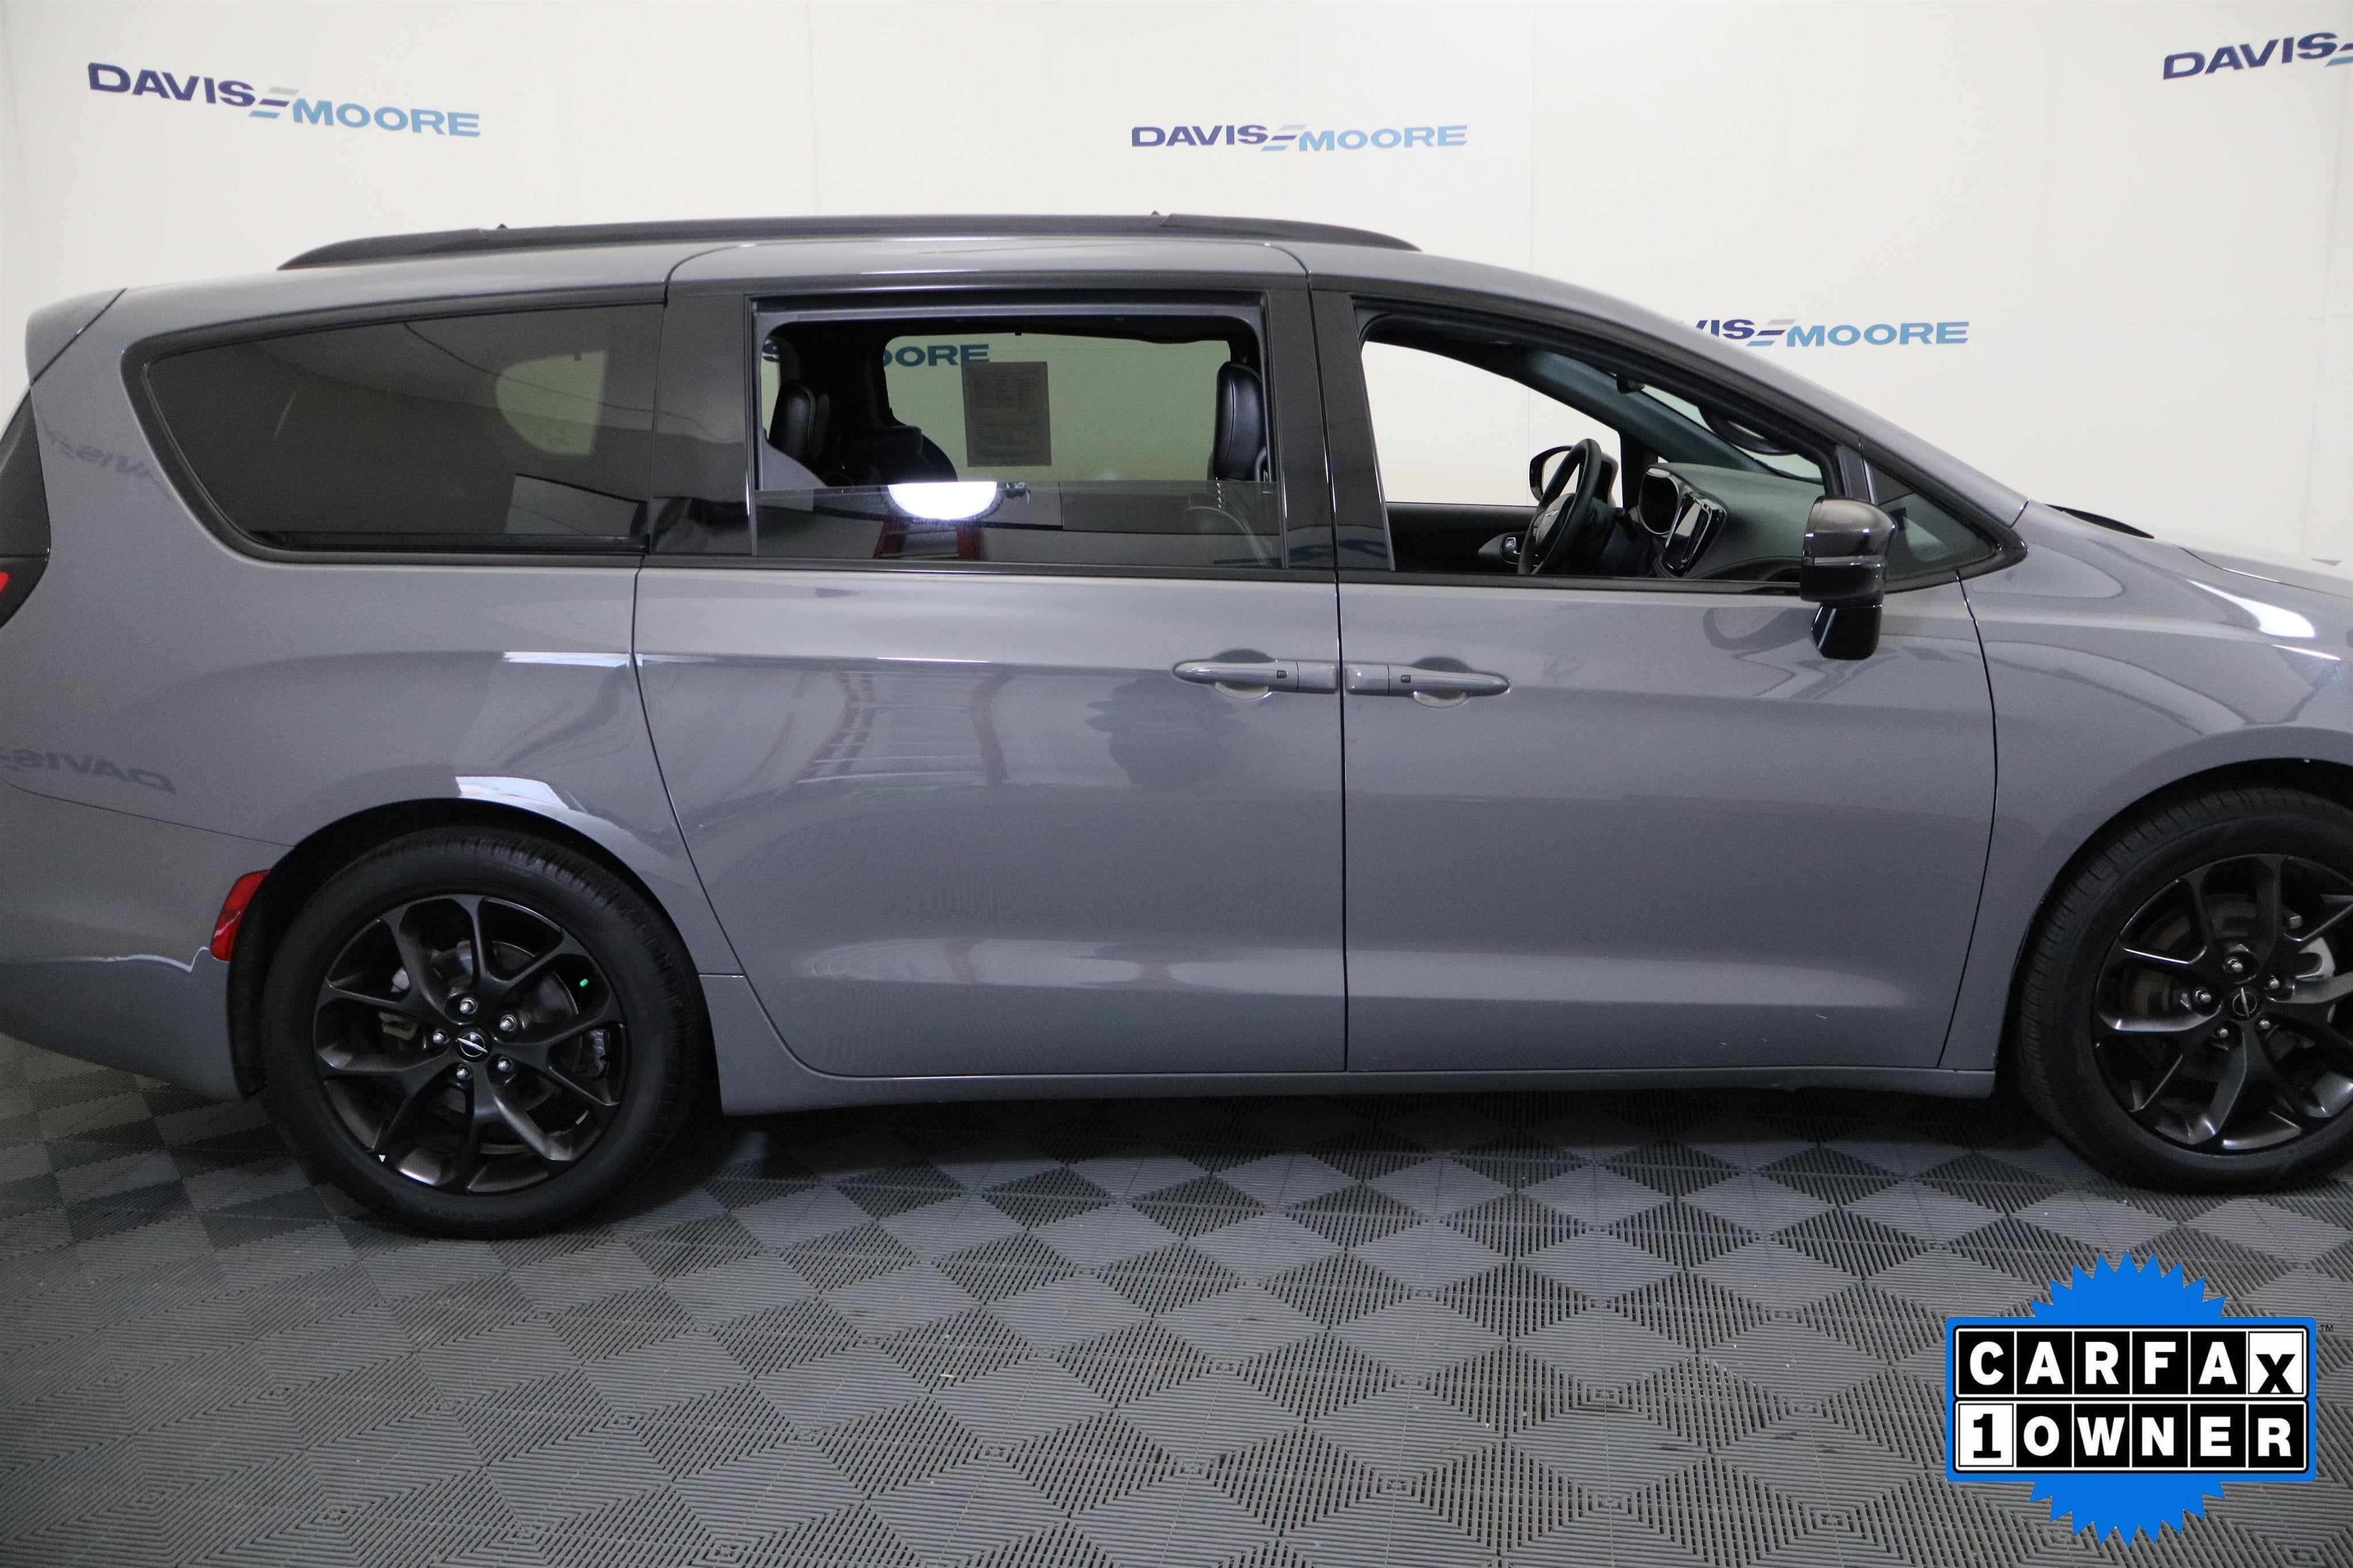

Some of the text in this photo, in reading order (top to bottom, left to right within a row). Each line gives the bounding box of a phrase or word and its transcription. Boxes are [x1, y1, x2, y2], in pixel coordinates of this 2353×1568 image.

[2162, 32, 2339, 80] DAVIS
[87, 61, 480, 137] DAVIS MOORE
[1131, 124, 1467, 152] DAVIS MOORE
[1786, 321, 1970, 347] MOORE
[883, 344, 990, 367] ORE
